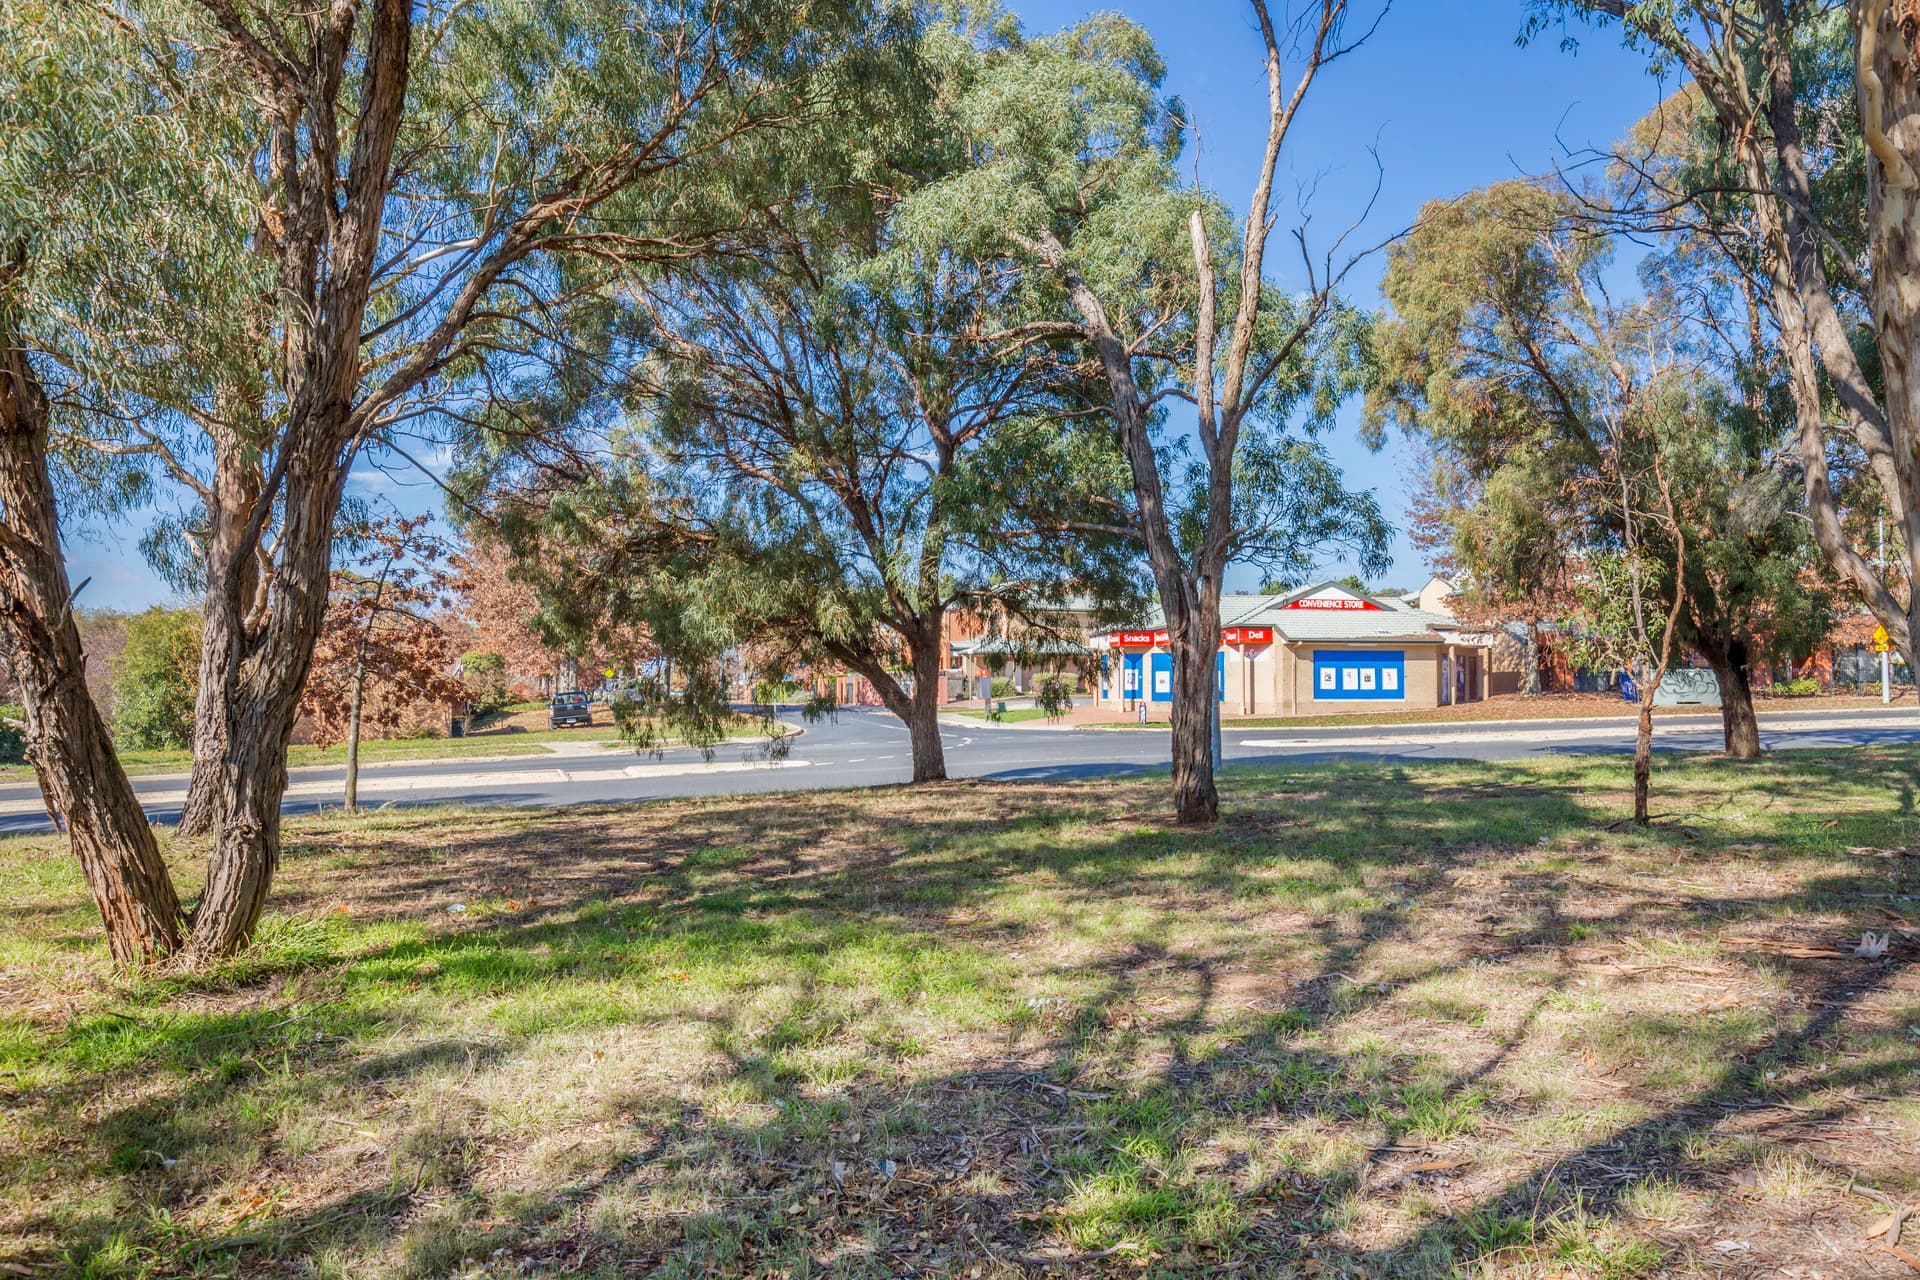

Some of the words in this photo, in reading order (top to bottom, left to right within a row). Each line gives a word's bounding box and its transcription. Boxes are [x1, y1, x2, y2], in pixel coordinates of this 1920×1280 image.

[1298, 600, 1342, 608] CONVENIENCE
[1344, 600, 1364, 608] STORE
[1123, 634, 1150, 642] Snacks
